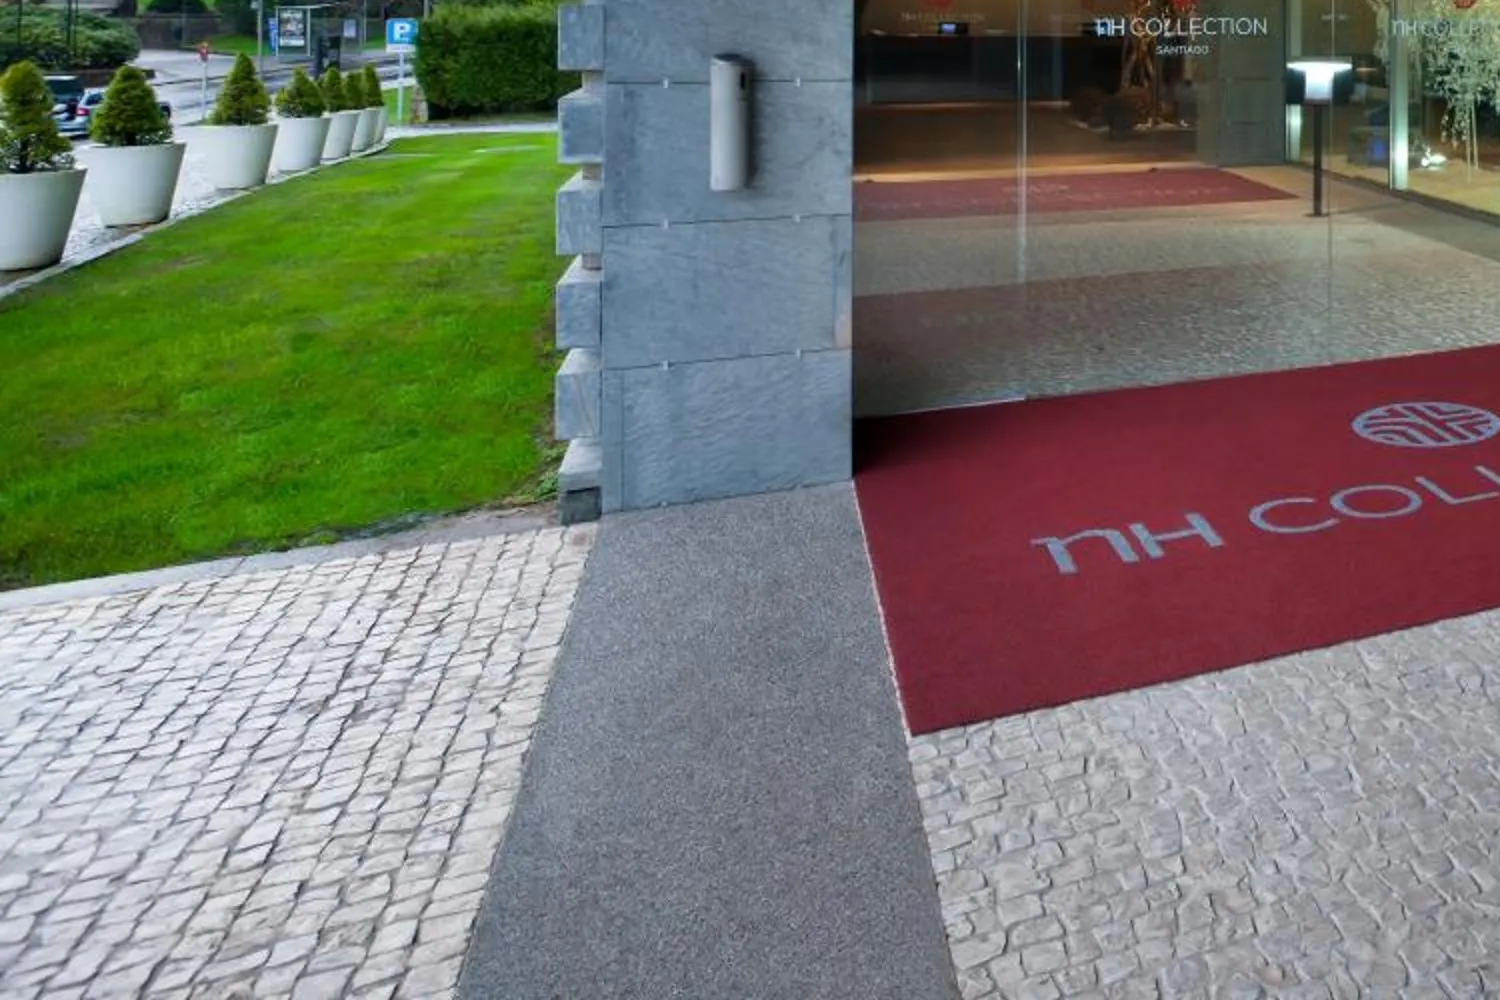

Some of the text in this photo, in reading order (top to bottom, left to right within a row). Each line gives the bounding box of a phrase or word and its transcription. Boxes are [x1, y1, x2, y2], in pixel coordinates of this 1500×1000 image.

[393, 23, 412, 41] P
[1129, 16, 1268, 37] COLLECTION
[1155, 44, 1209, 56] SANTIAGO
